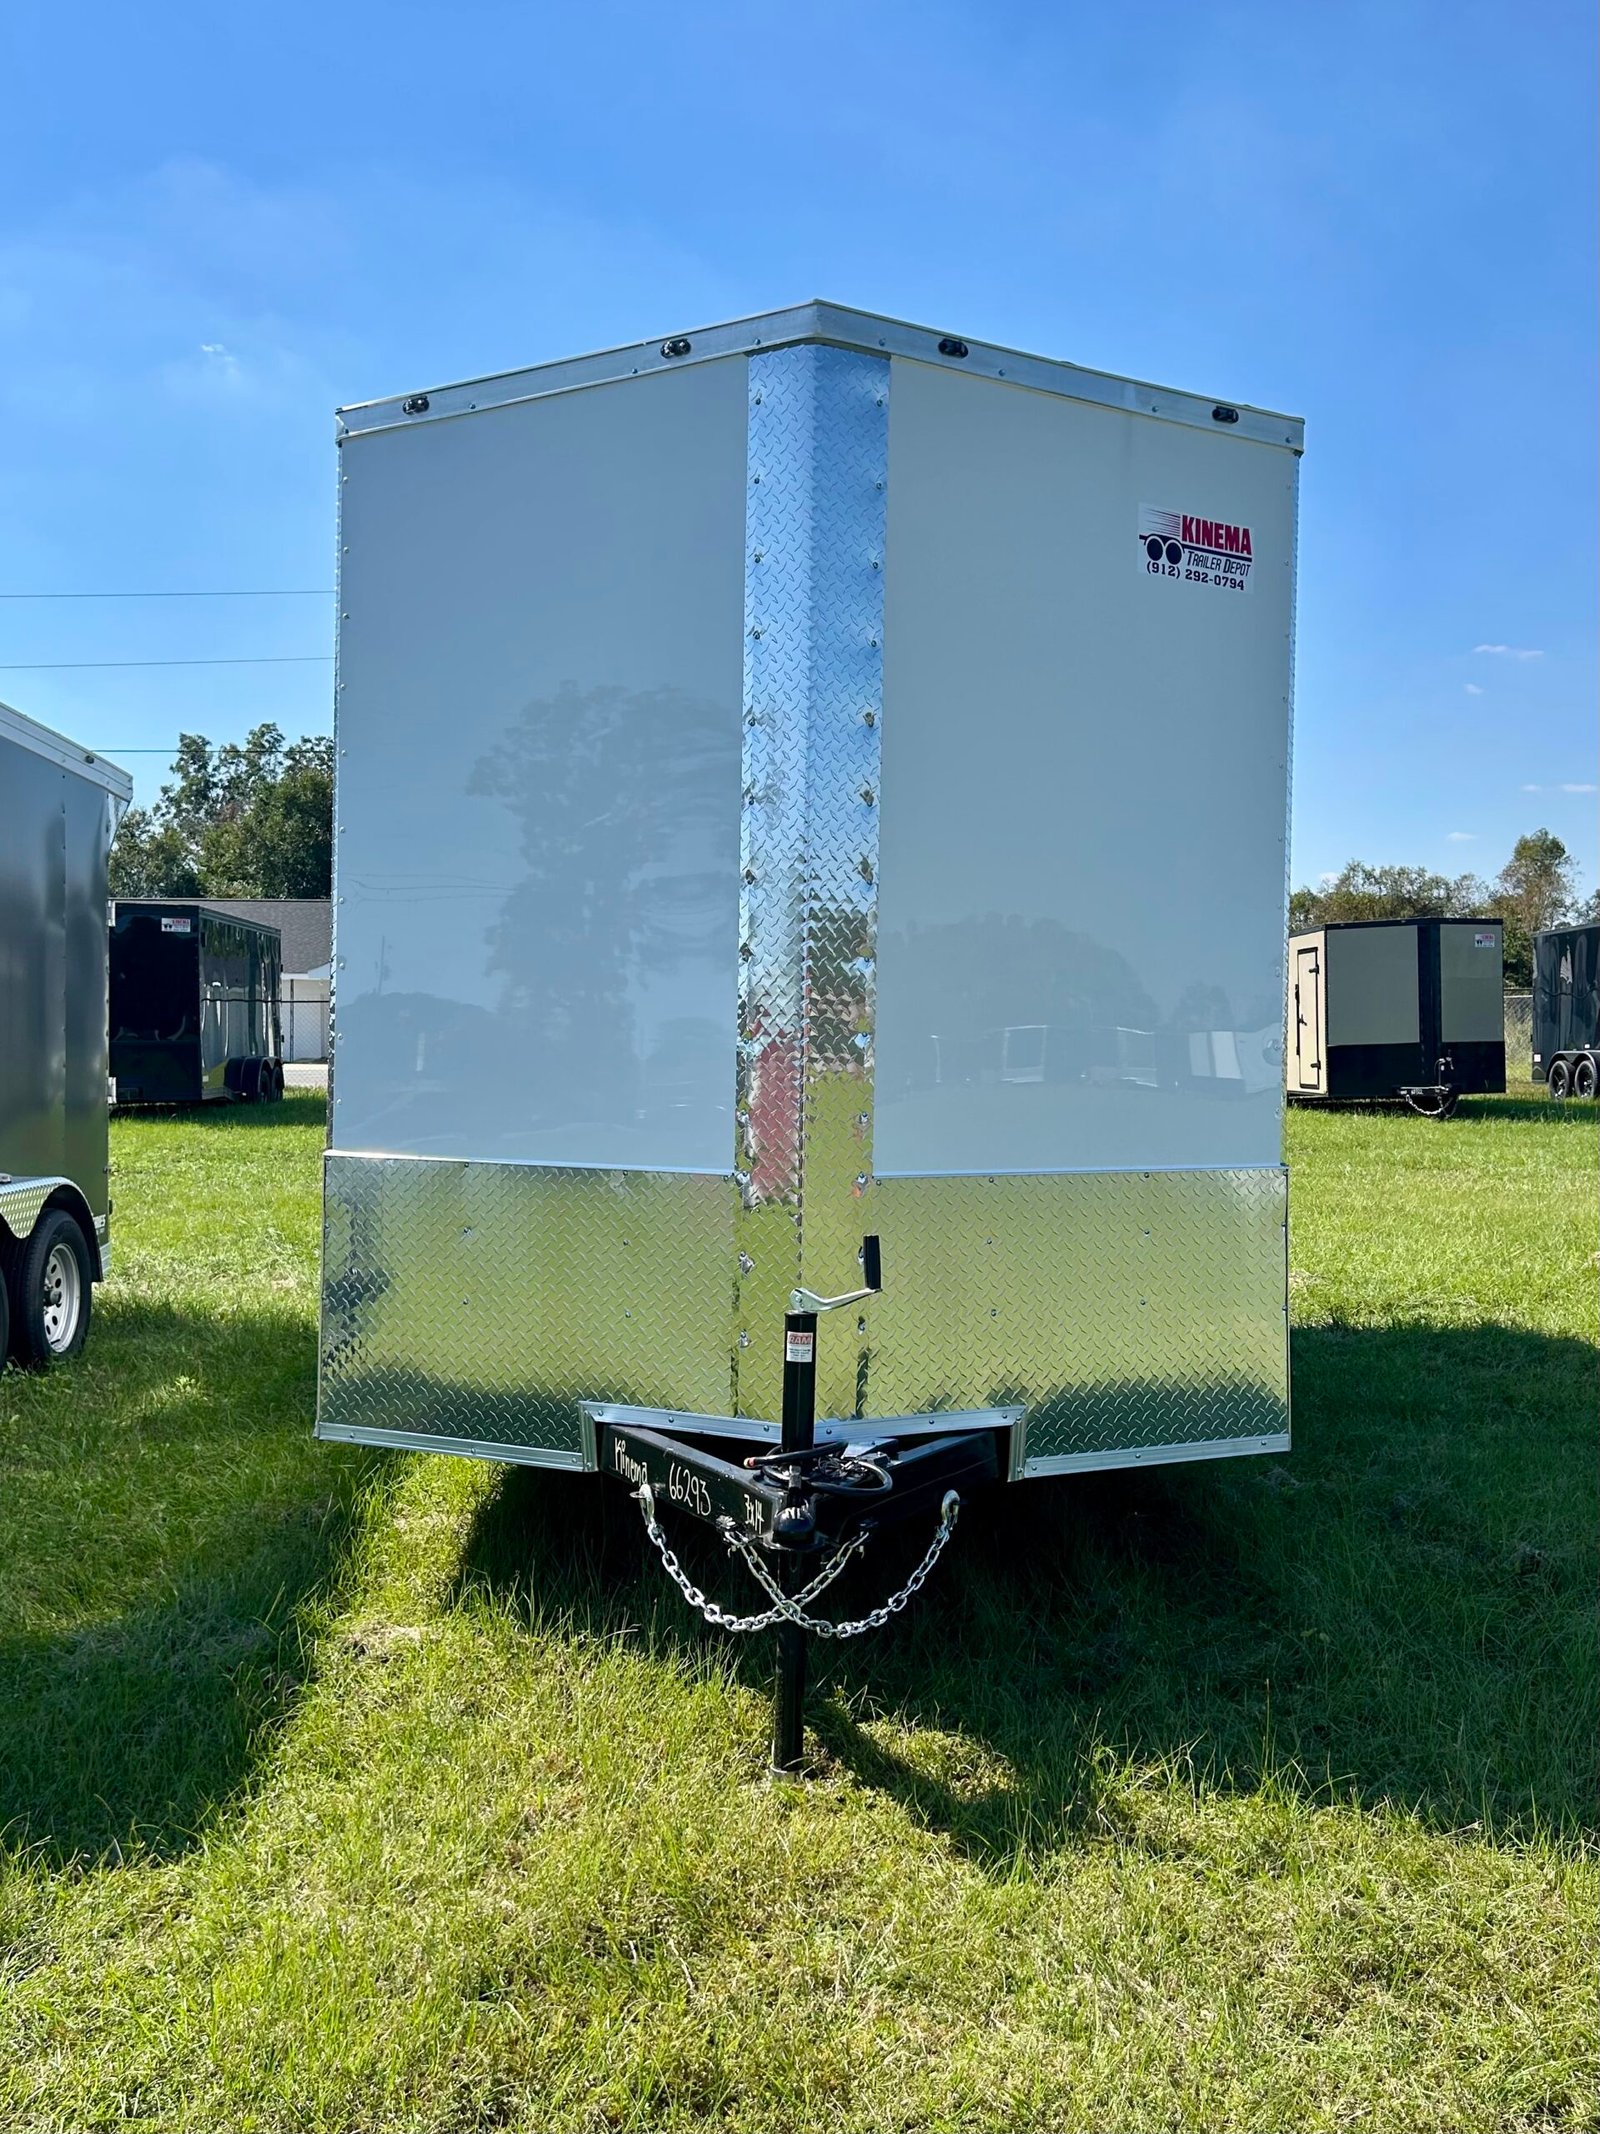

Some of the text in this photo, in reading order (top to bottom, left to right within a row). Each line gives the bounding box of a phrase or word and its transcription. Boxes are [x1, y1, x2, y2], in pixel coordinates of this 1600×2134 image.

[1182, 514, 1252, 555] KINEMA
[1146, 561, 1244, 591] (912) 292-0794
[669, 1462, 711, 1516] 66293
